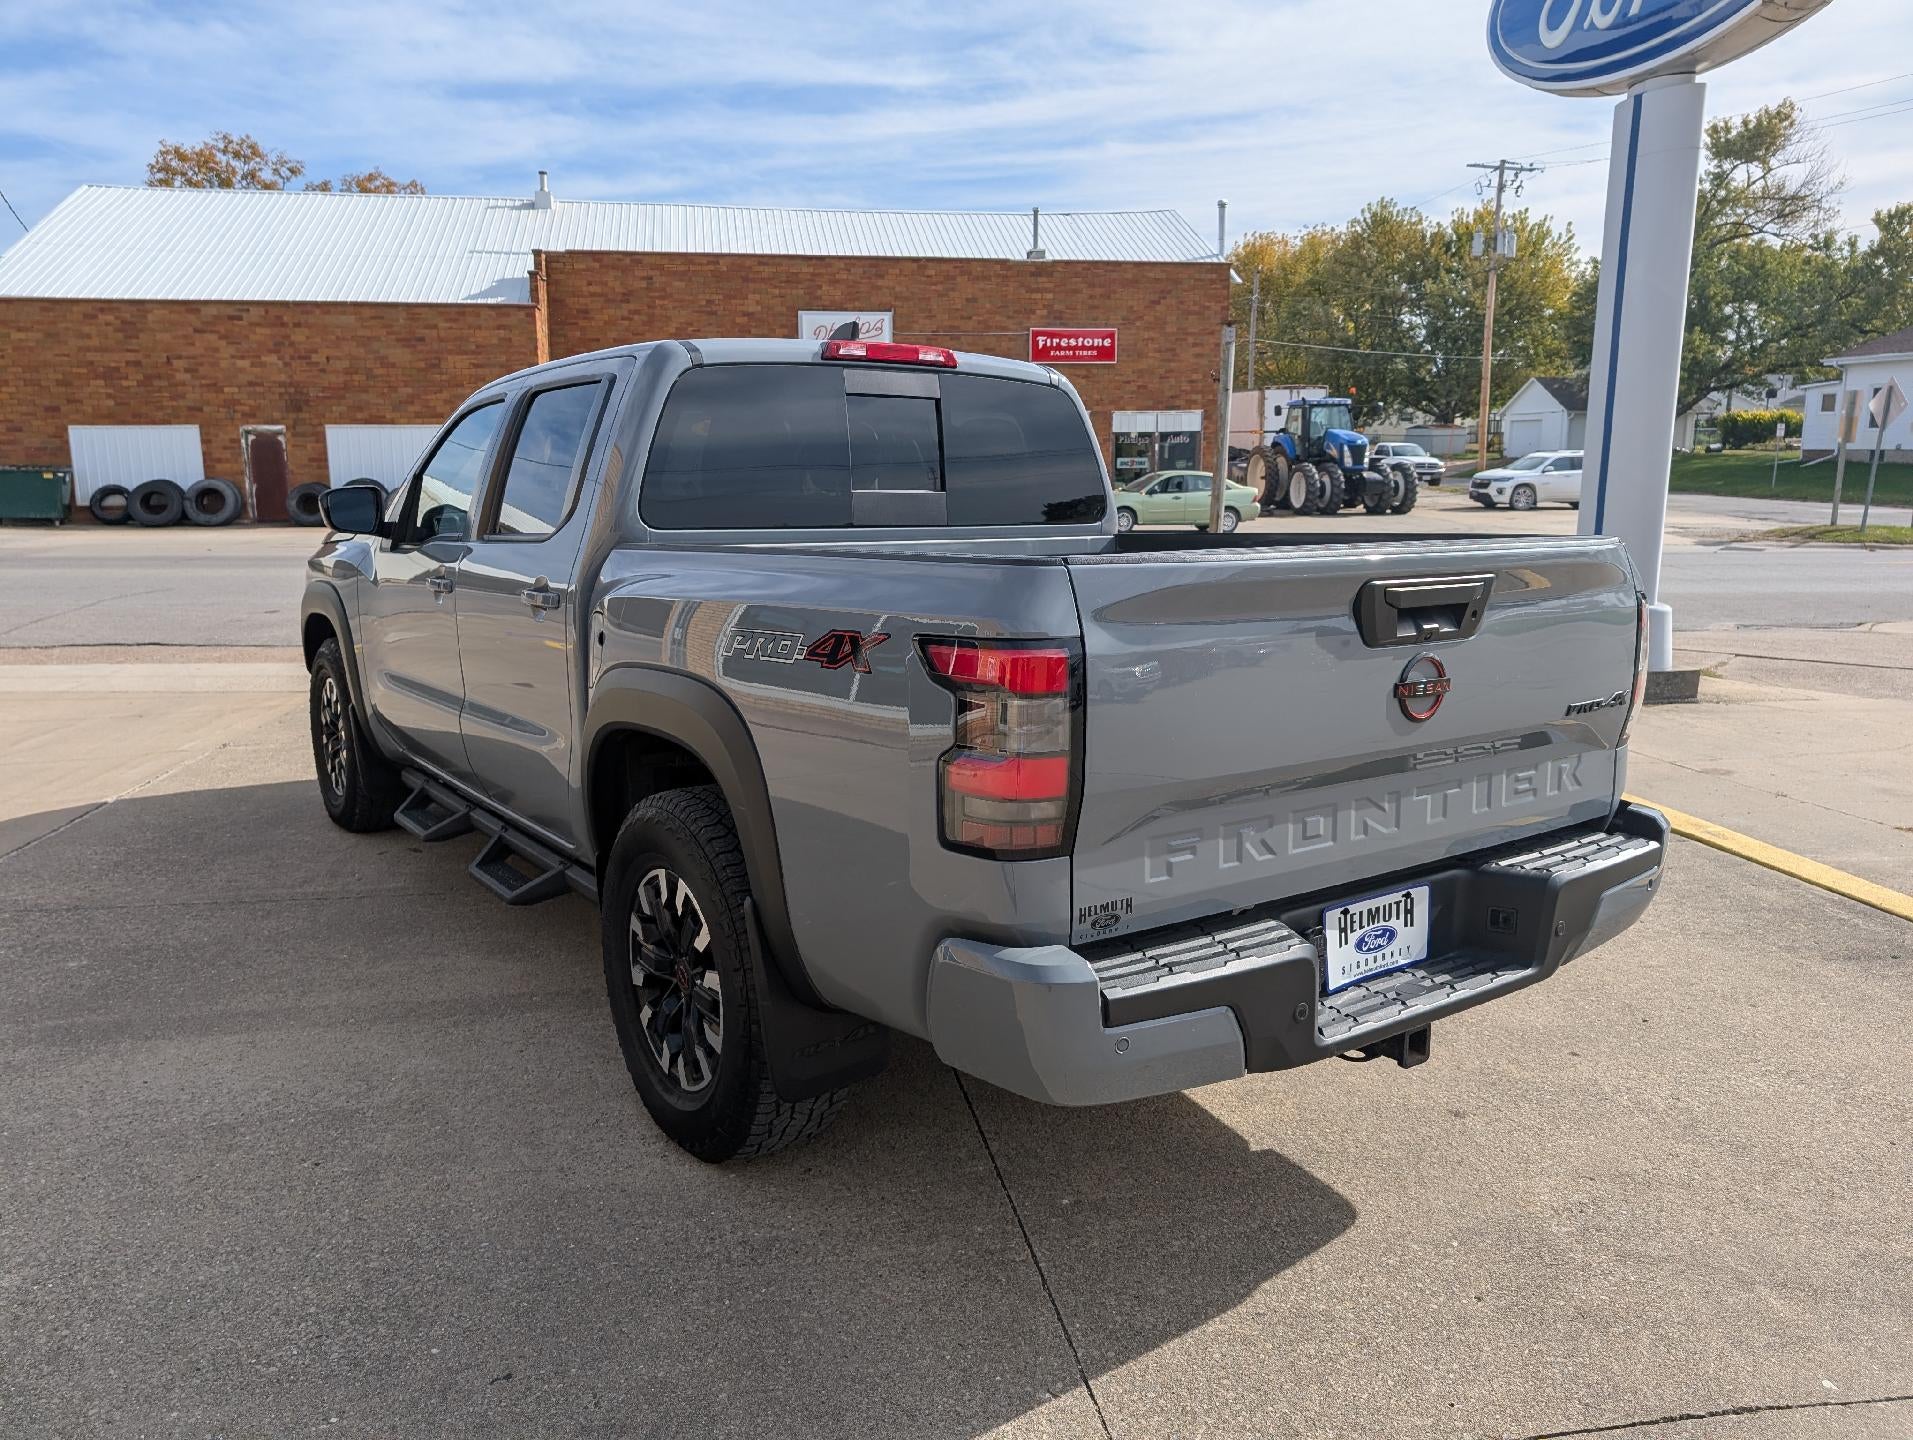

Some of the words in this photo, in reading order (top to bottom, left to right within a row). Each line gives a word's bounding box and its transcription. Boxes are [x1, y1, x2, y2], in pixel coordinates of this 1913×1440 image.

[1036, 335, 1112, 350] Firestone
[1167, 434, 1190, 444] Auto
[1398, 681, 1450, 696] NISSAN
[1144, 754, 1582, 885] FRONTIER
[1079, 896, 1133, 926] HELMUTH
[1338, 894, 1414, 949] HELMUTH
[1362, 930, 1390, 952] Ford
[1341, 945, 1411, 976] SIGOURNEY
